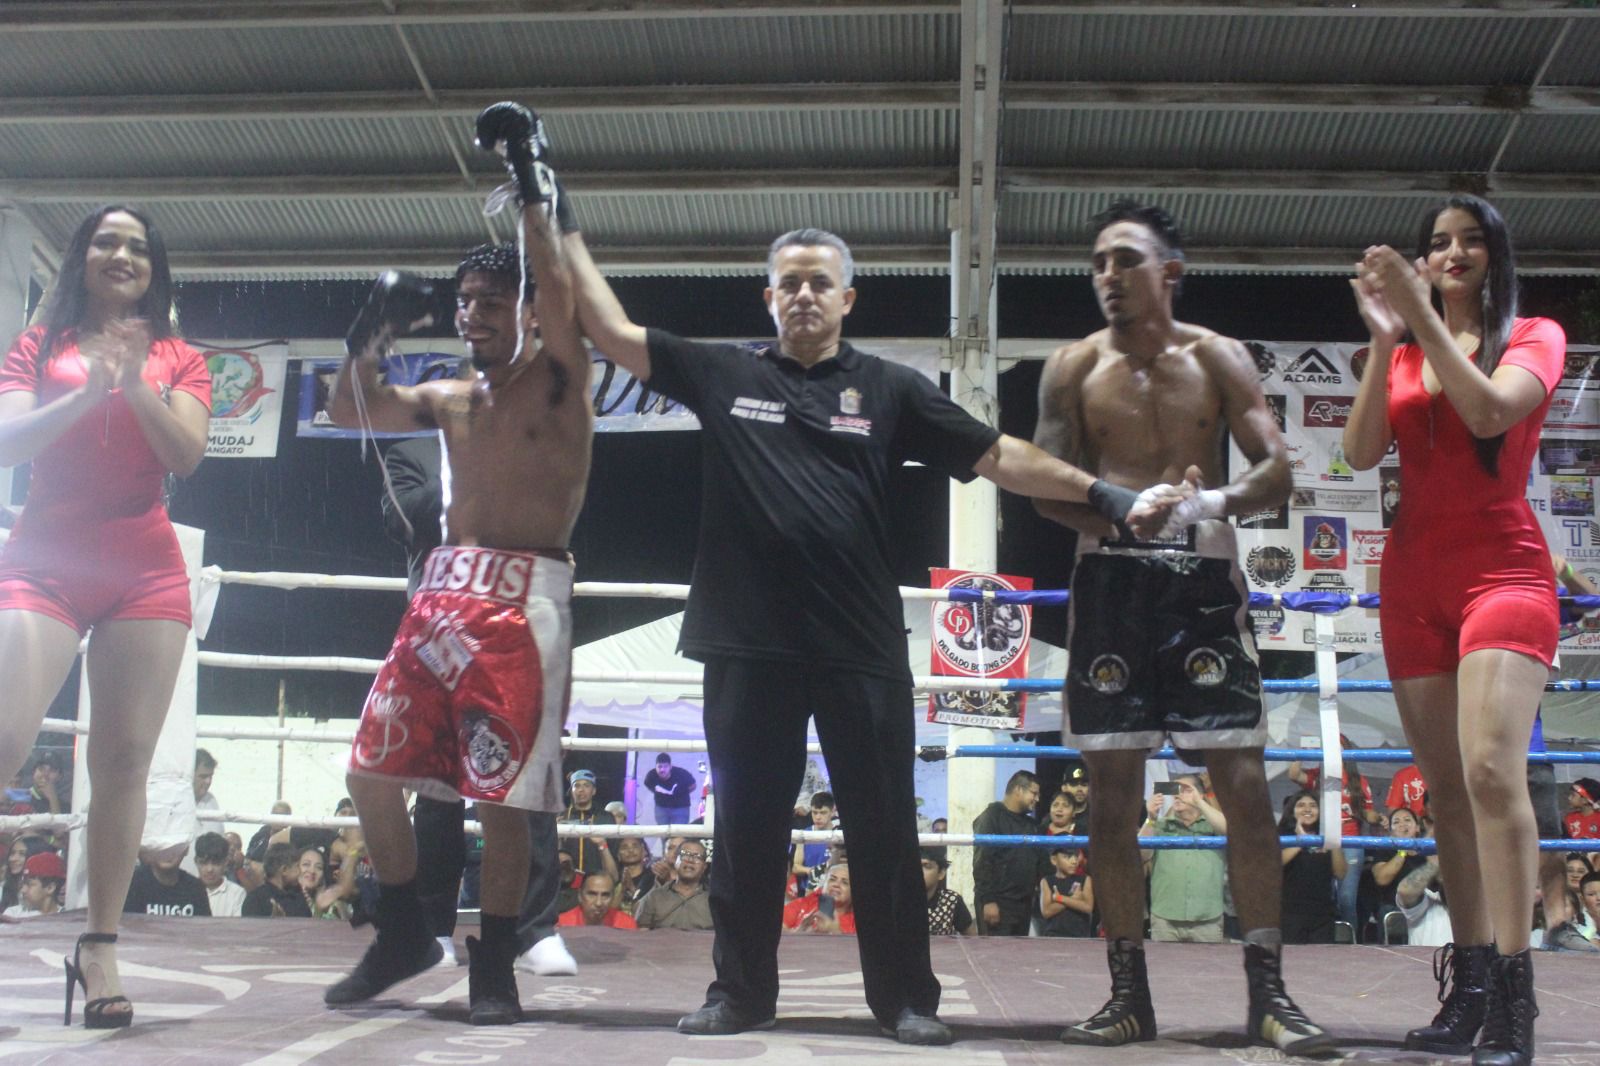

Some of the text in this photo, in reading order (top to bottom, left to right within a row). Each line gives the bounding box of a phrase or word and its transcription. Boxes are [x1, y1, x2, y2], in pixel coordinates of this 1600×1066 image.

[1283, 374, 1342, 385] ADAMS
[418, 549, 529, 599] JESUS
[938, 639, 970, 670] DELGADO
[1000, 645, 1019, 664] CLUB
[147, 904, 195, 917] HUGO
